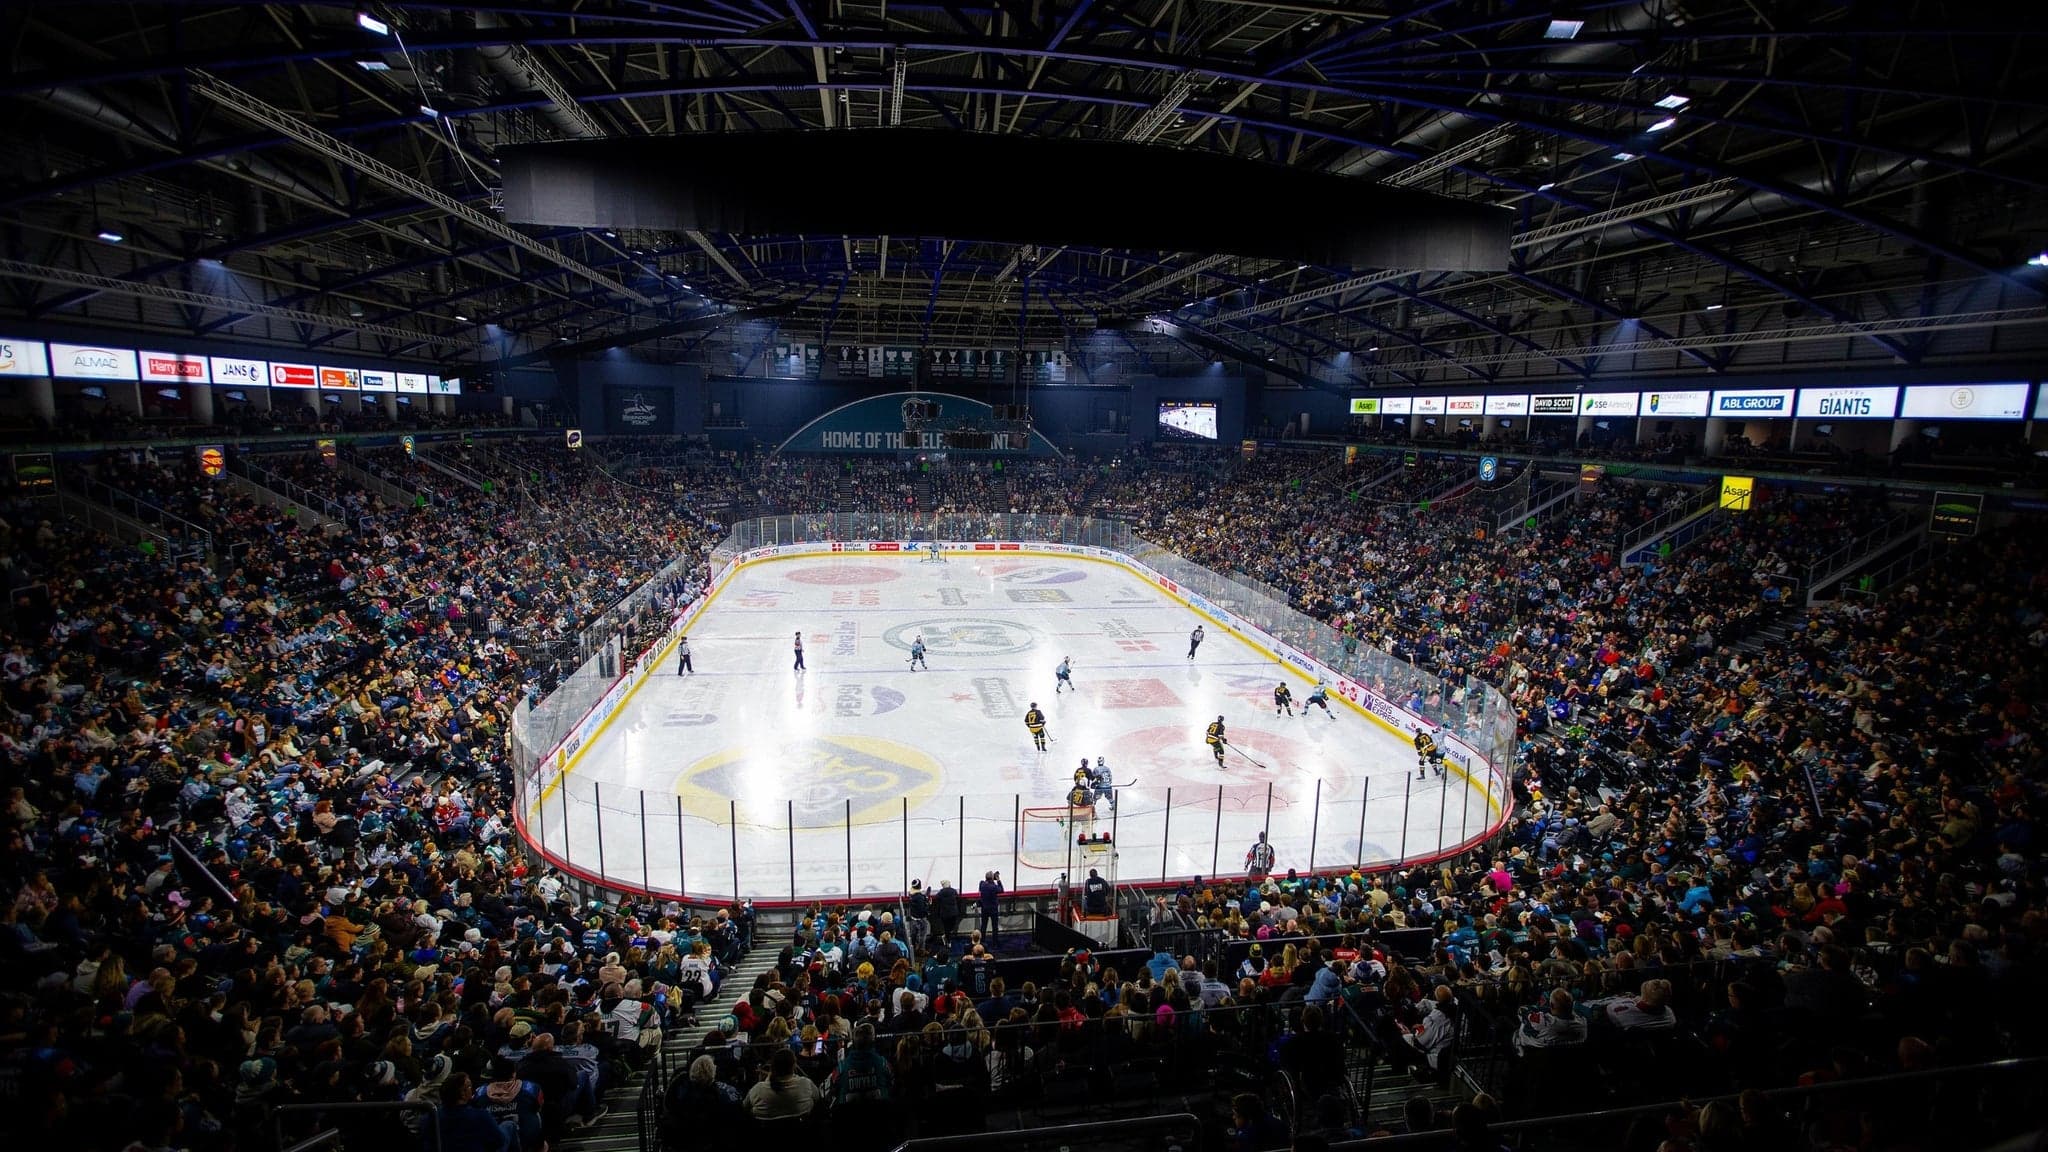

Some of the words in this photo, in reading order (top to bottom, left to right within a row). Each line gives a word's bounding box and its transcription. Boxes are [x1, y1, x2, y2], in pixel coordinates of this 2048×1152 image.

[74, 355, 118, 369] ALMAC
[151, 360, 176, 374] Harry
[177, 362, 201, 376] Corry
[223, 363, 247, 376] JANS
[1358, 402, 1373, 410] Asap
[1535, 399, 1553, 407] DAVID
[1553, 398, 1573, 407] SCOTT
[1594, 400, 1608, 408] sse
[1722, 398, 1742, 409] ABL
[1743, 398, 1781, 408] GROUP
[1819, 398, 1872, 415] GIANTS
[822, 431, 862, 449] HOME
[864, 431, 882, 449] OF
[1723, 485, 1751, 497] Asap
[835, 684, 863, 717] PEPSI
[1374, 698, 1393, 714] SIGNS
[1372, 706, 1400, 728] EXPRESS
[685, 970, 701, 983] 22
[974, 972, 986, 994] 6
